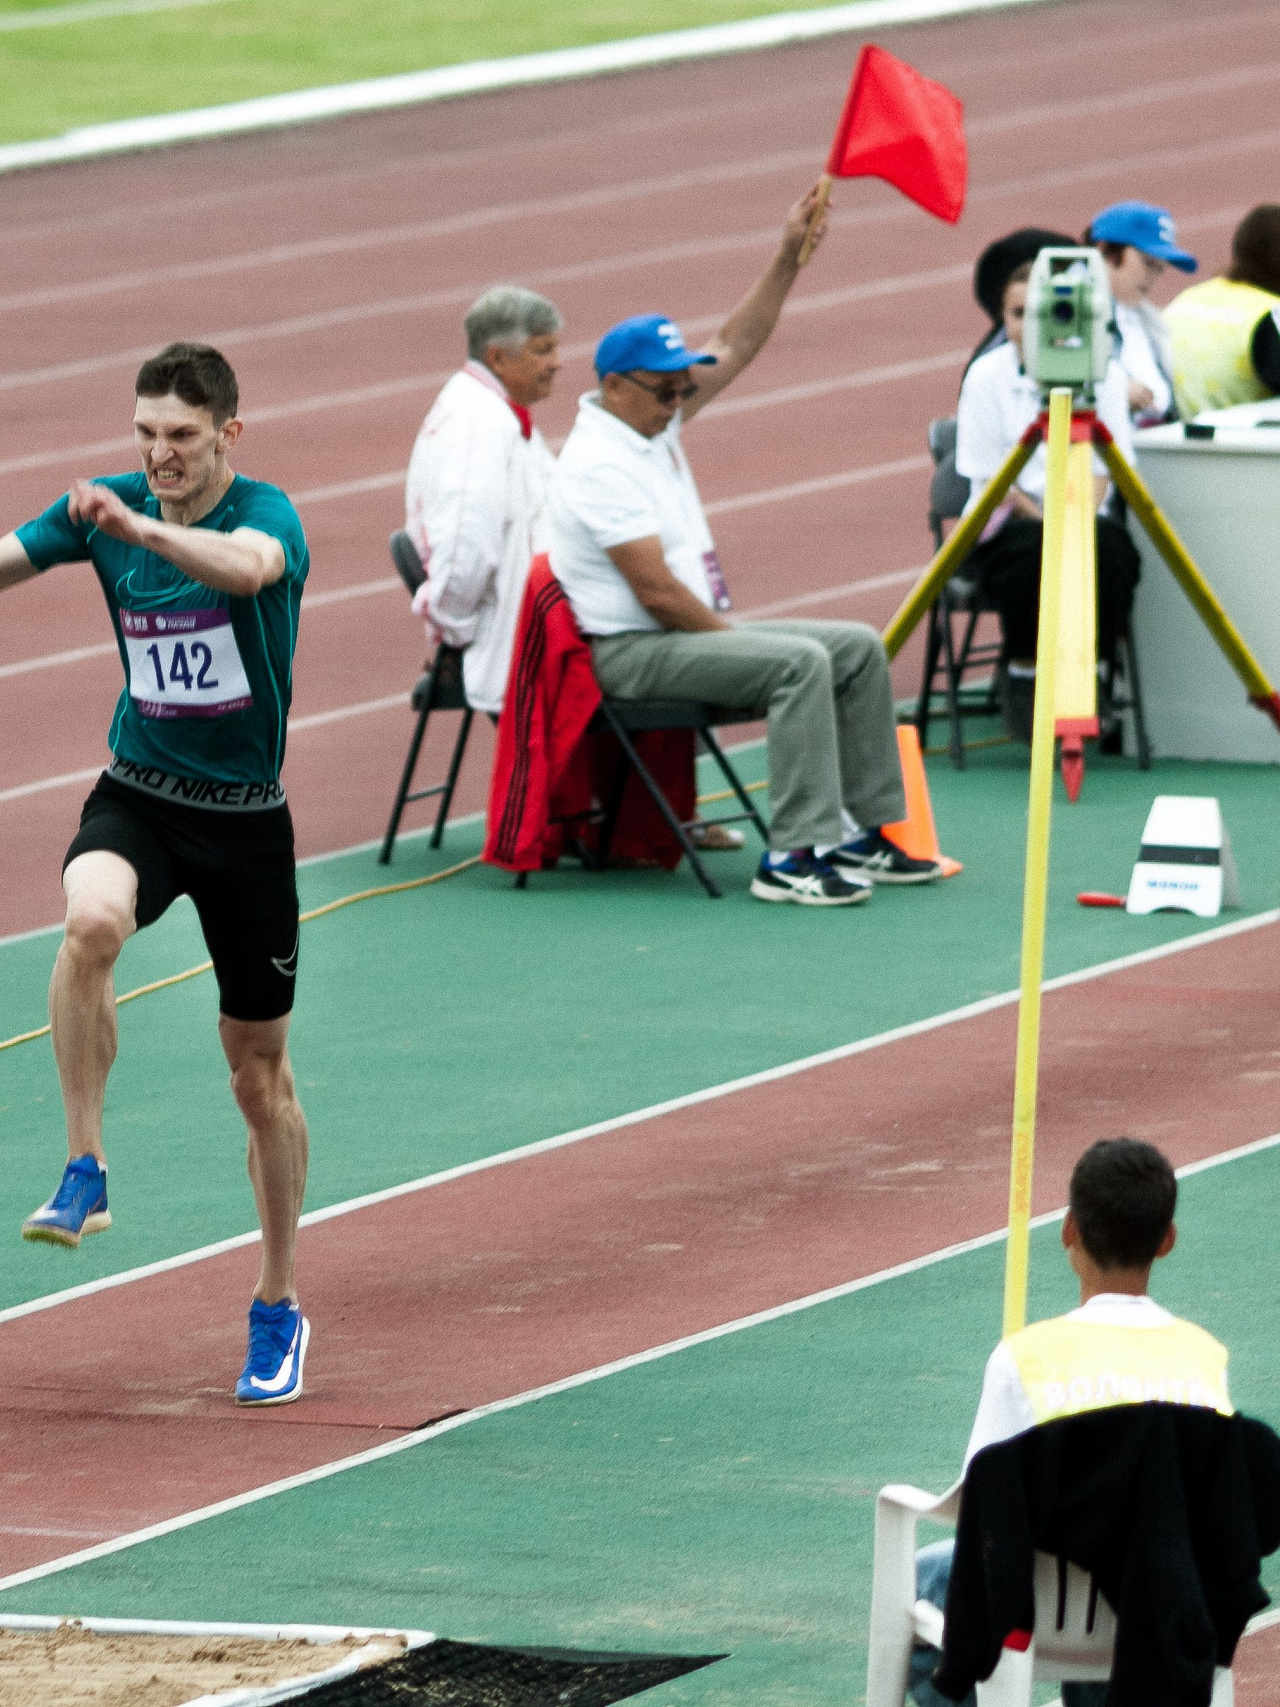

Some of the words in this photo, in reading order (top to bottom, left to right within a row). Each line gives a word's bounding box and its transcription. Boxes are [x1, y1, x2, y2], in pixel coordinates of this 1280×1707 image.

[146, 641, 219, 692] 142
[111, 758, 168, 789] PRO
[170, 776, 244, 805] NIKE
